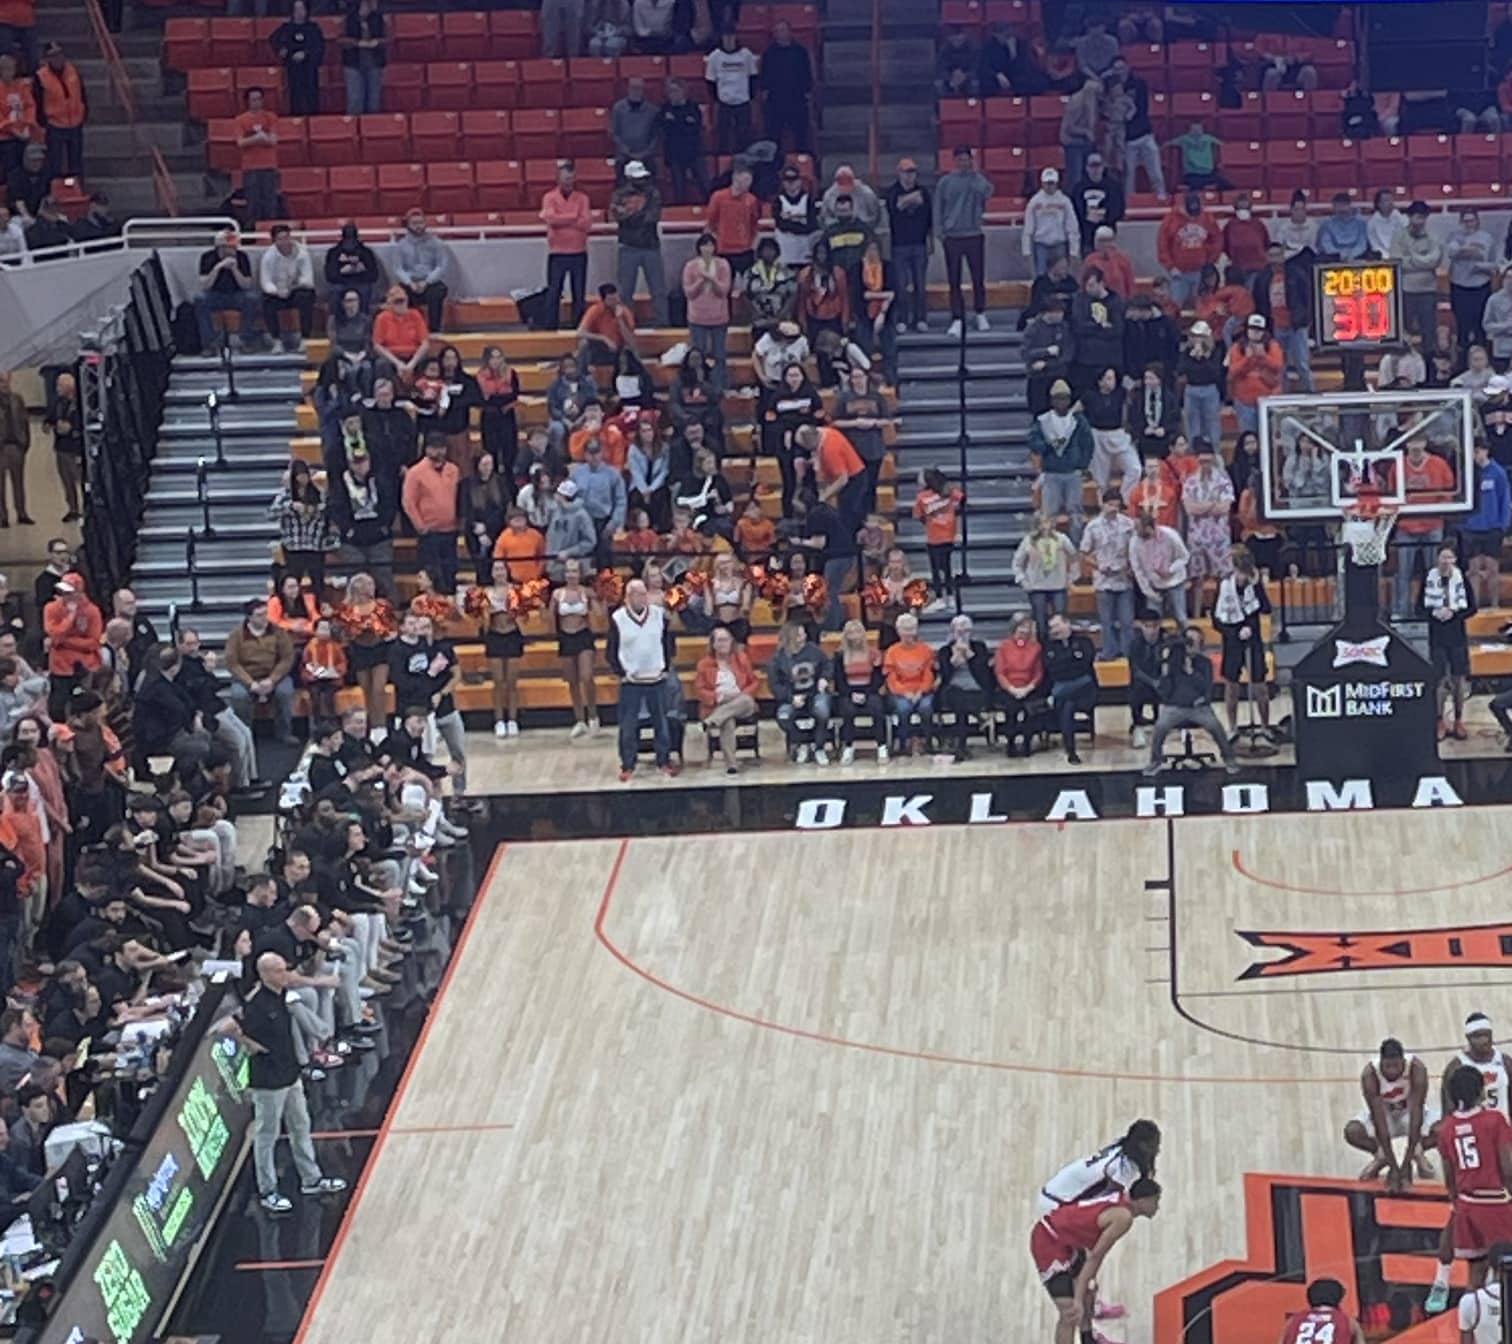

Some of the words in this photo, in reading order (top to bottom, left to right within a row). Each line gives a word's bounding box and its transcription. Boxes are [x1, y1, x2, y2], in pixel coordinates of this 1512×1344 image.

[1324, 267, 1393, 296] 20:00
[1333, 294, 1389, 340] 30
[1345, 701, 1393, 716] BANK
[796, 776, 1463, 829] OKLAHOMA
[1454, 1136, 1480, 1169] 15
